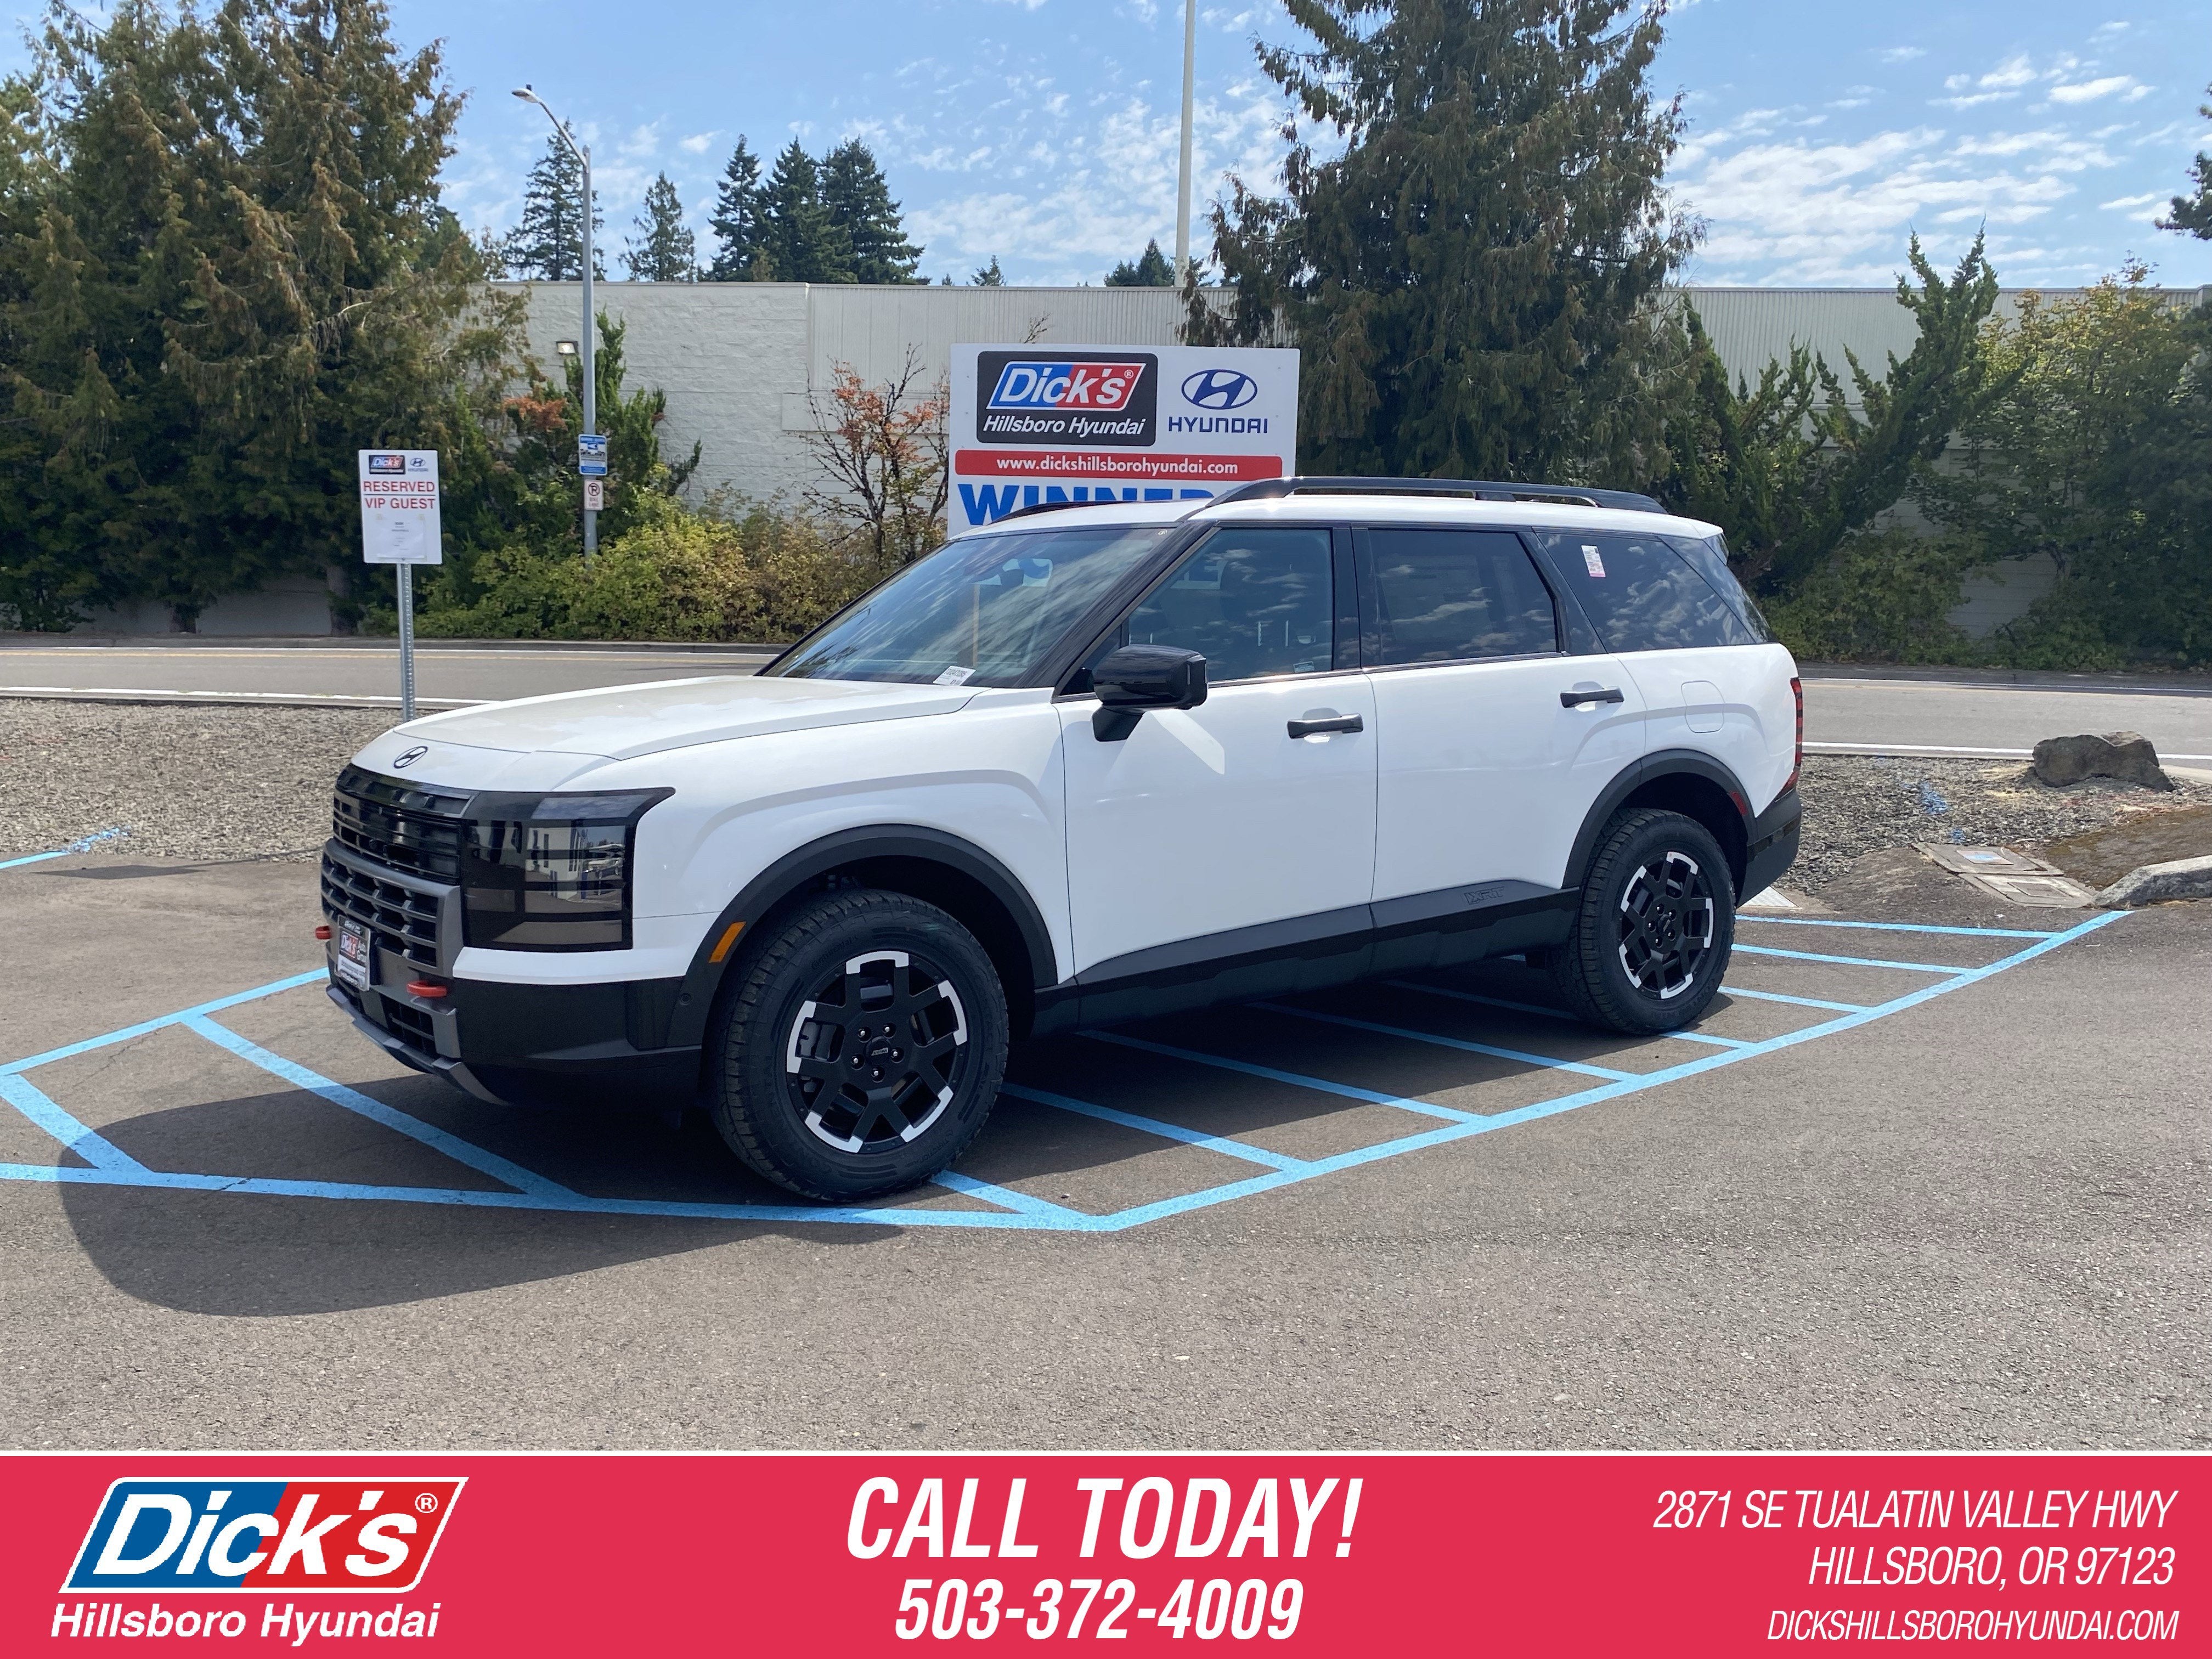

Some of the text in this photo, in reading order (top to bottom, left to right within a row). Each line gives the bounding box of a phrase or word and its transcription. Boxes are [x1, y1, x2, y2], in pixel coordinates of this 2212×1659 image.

[999, 366, 1126, 404] Dick's
[983, 415, 1146, 437] Hillsboro Hyundai
[1169, 416, 1267, 434] HYUNDAI
[996, 455, 1238, 475] www.dickshillsborohyundai.com
[363, 481, 435, 492] RESERVED
[365, 498, 436, 509] VIP GUEST
